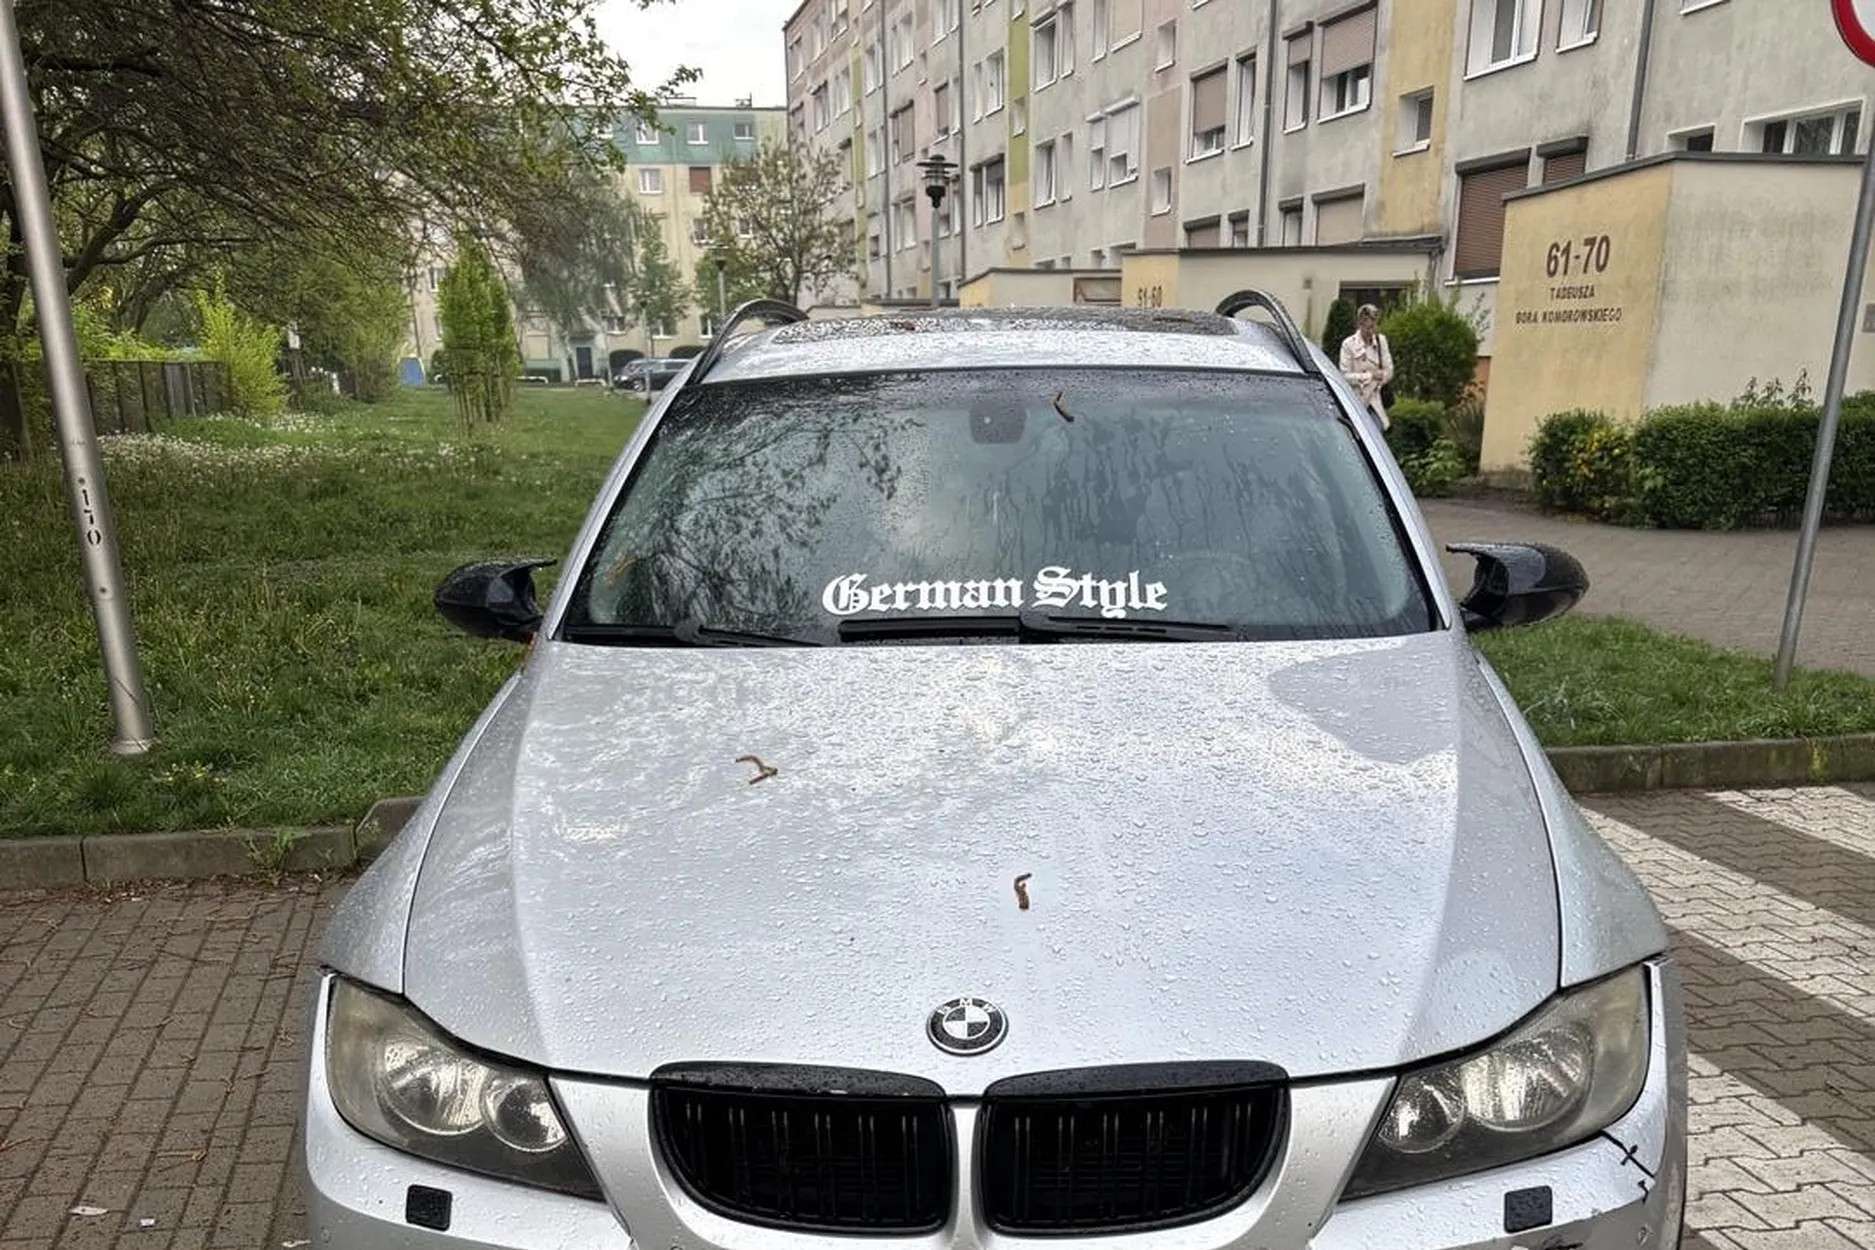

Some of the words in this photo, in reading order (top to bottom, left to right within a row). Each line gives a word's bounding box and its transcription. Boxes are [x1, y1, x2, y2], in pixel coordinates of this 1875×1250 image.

[1546, 235, 1611, 278] 61-70
[1550, 285, 1595, 300] TADEUSZA
[822, 573, 1024, 615] German
[1031, 566, 1168, 618] Style
[936, 997, 997, 1015] BMW
